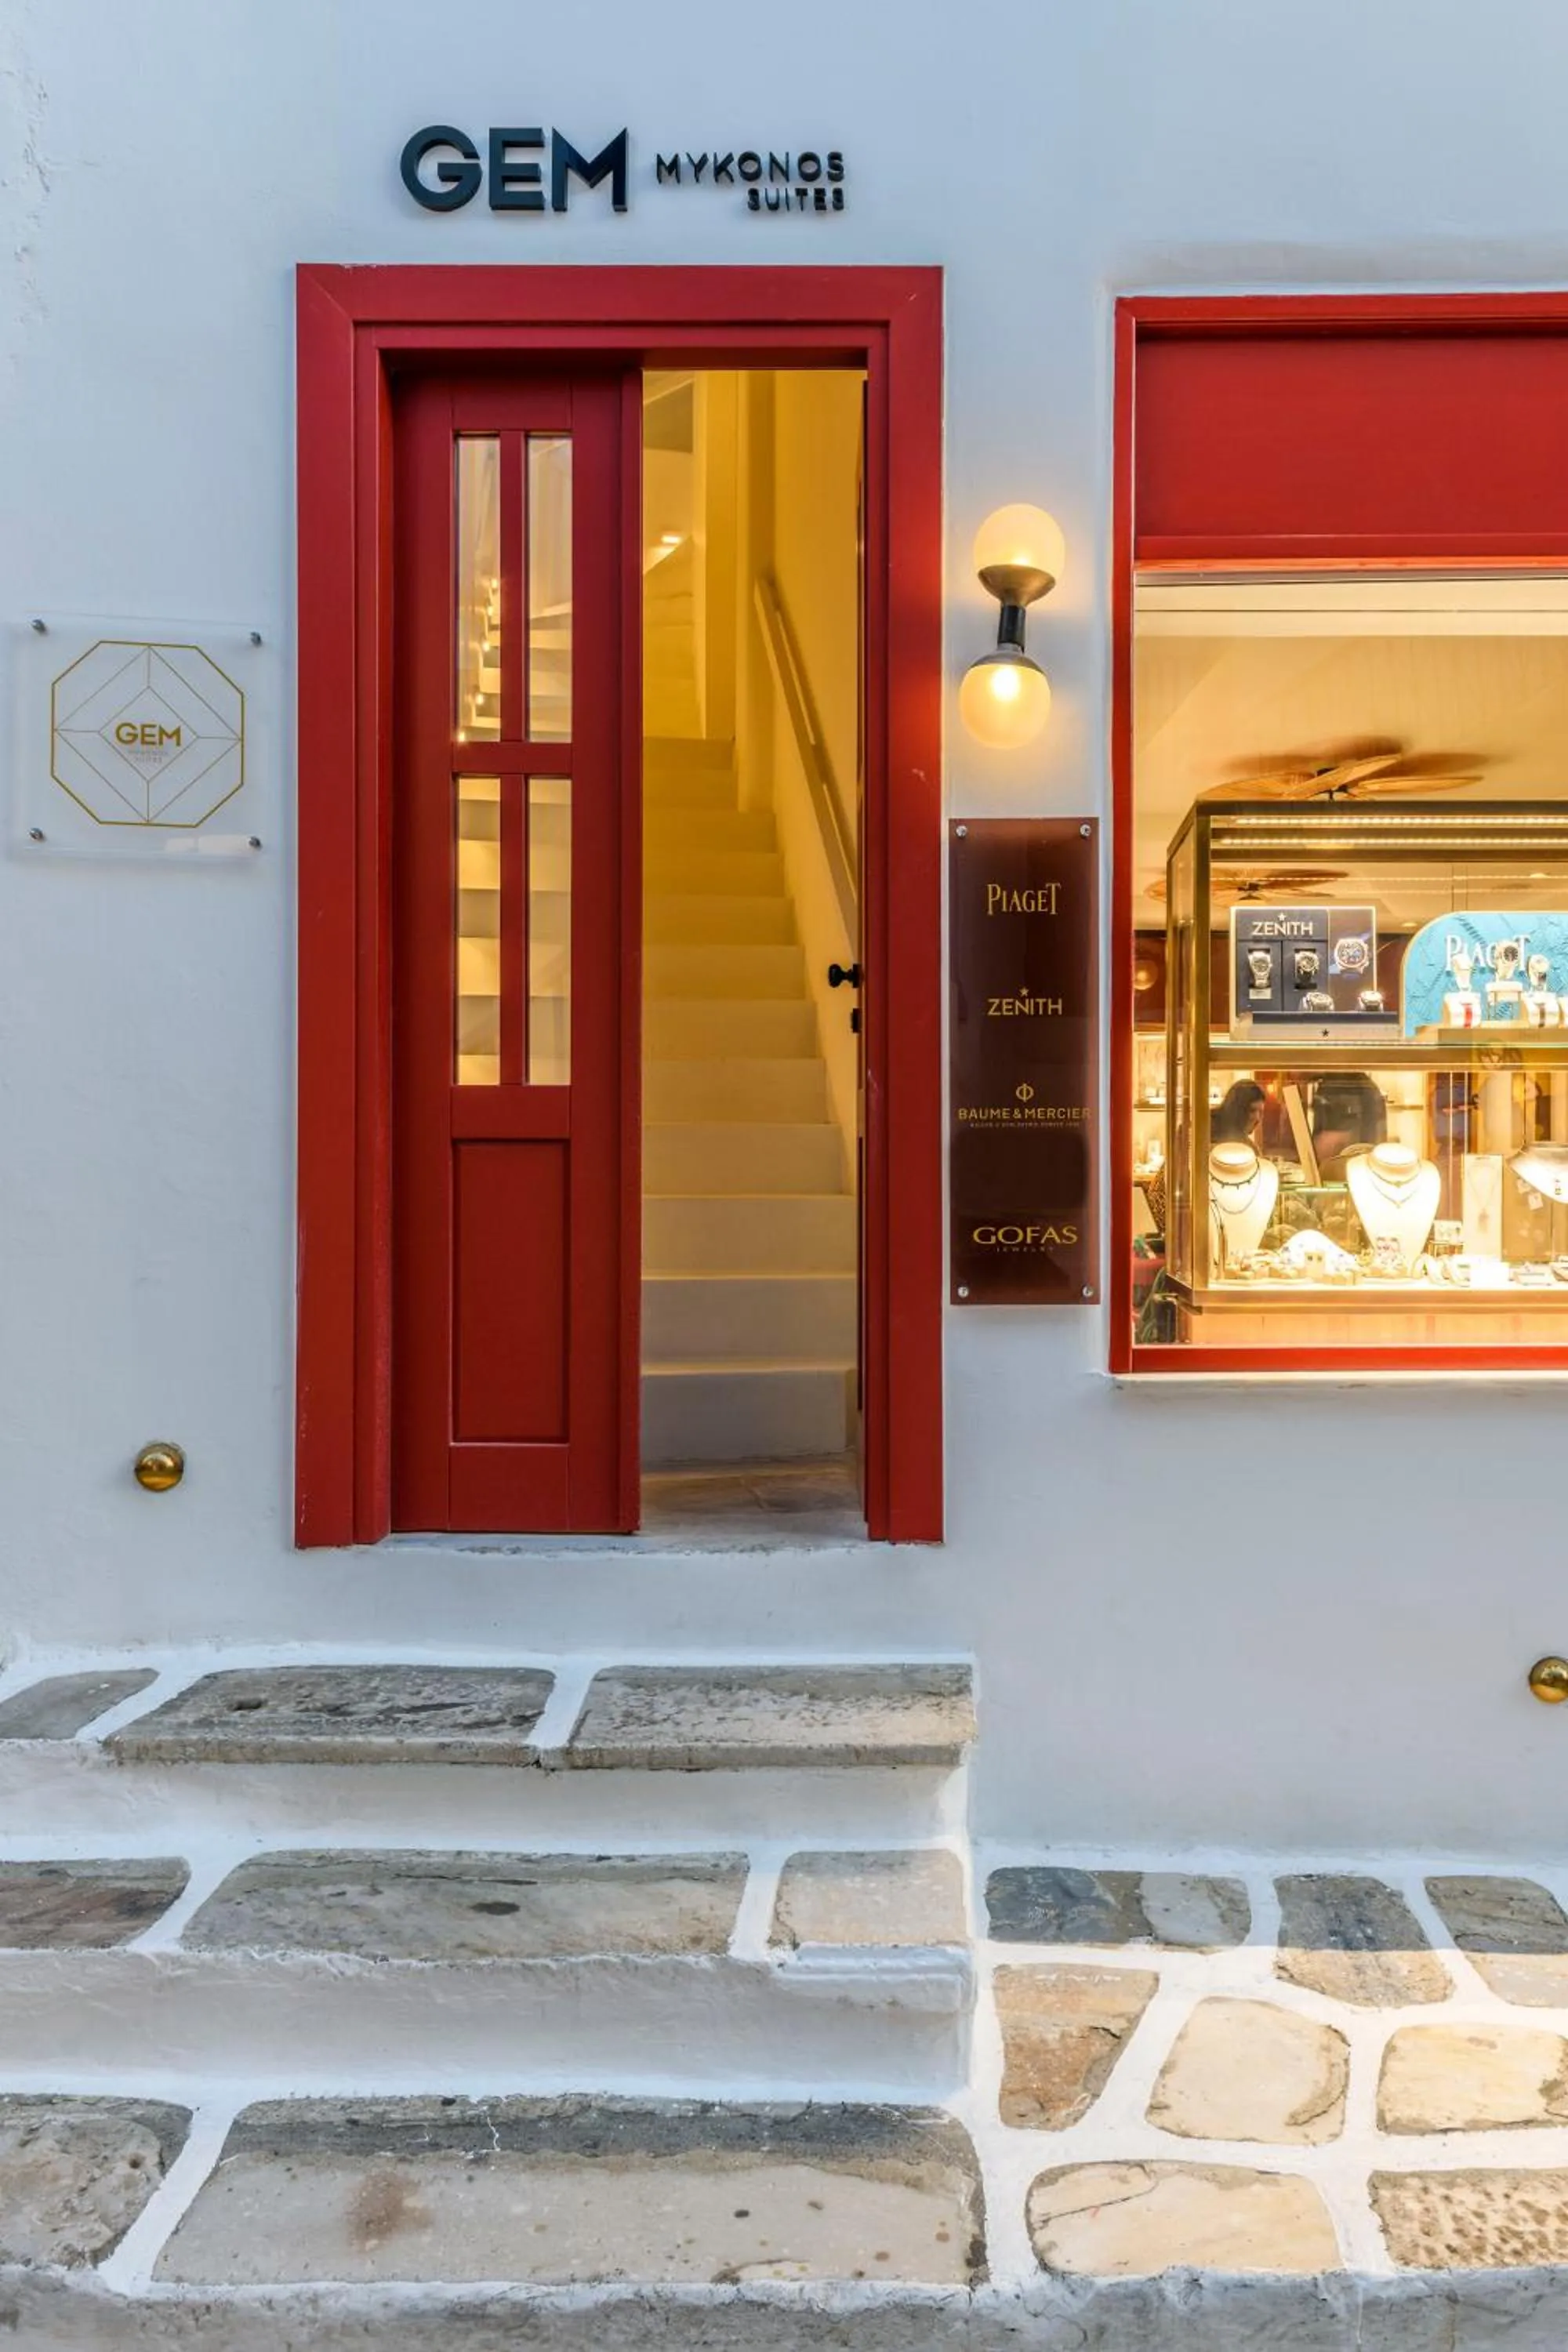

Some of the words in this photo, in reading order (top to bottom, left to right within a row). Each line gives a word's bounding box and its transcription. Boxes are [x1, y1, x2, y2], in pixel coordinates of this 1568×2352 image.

[401, 125, 627, 212] GEM
[656, 151, 844, 184] MYKONOS
[747, 187, 844, 211] SUITES
[115, 722, 181, 746] GEM
[986, 883, 1062, 916] PIAGET
[1252, 921, 1313, 936] ZENITH
[987, 998, 1062, 1015] ZENITH
[958, 1108, 1010, 1120] BAUME
[1024, 1108, 1091, 1120] MERCIER
[973, 1225, 1078, 1244] GOFAS
